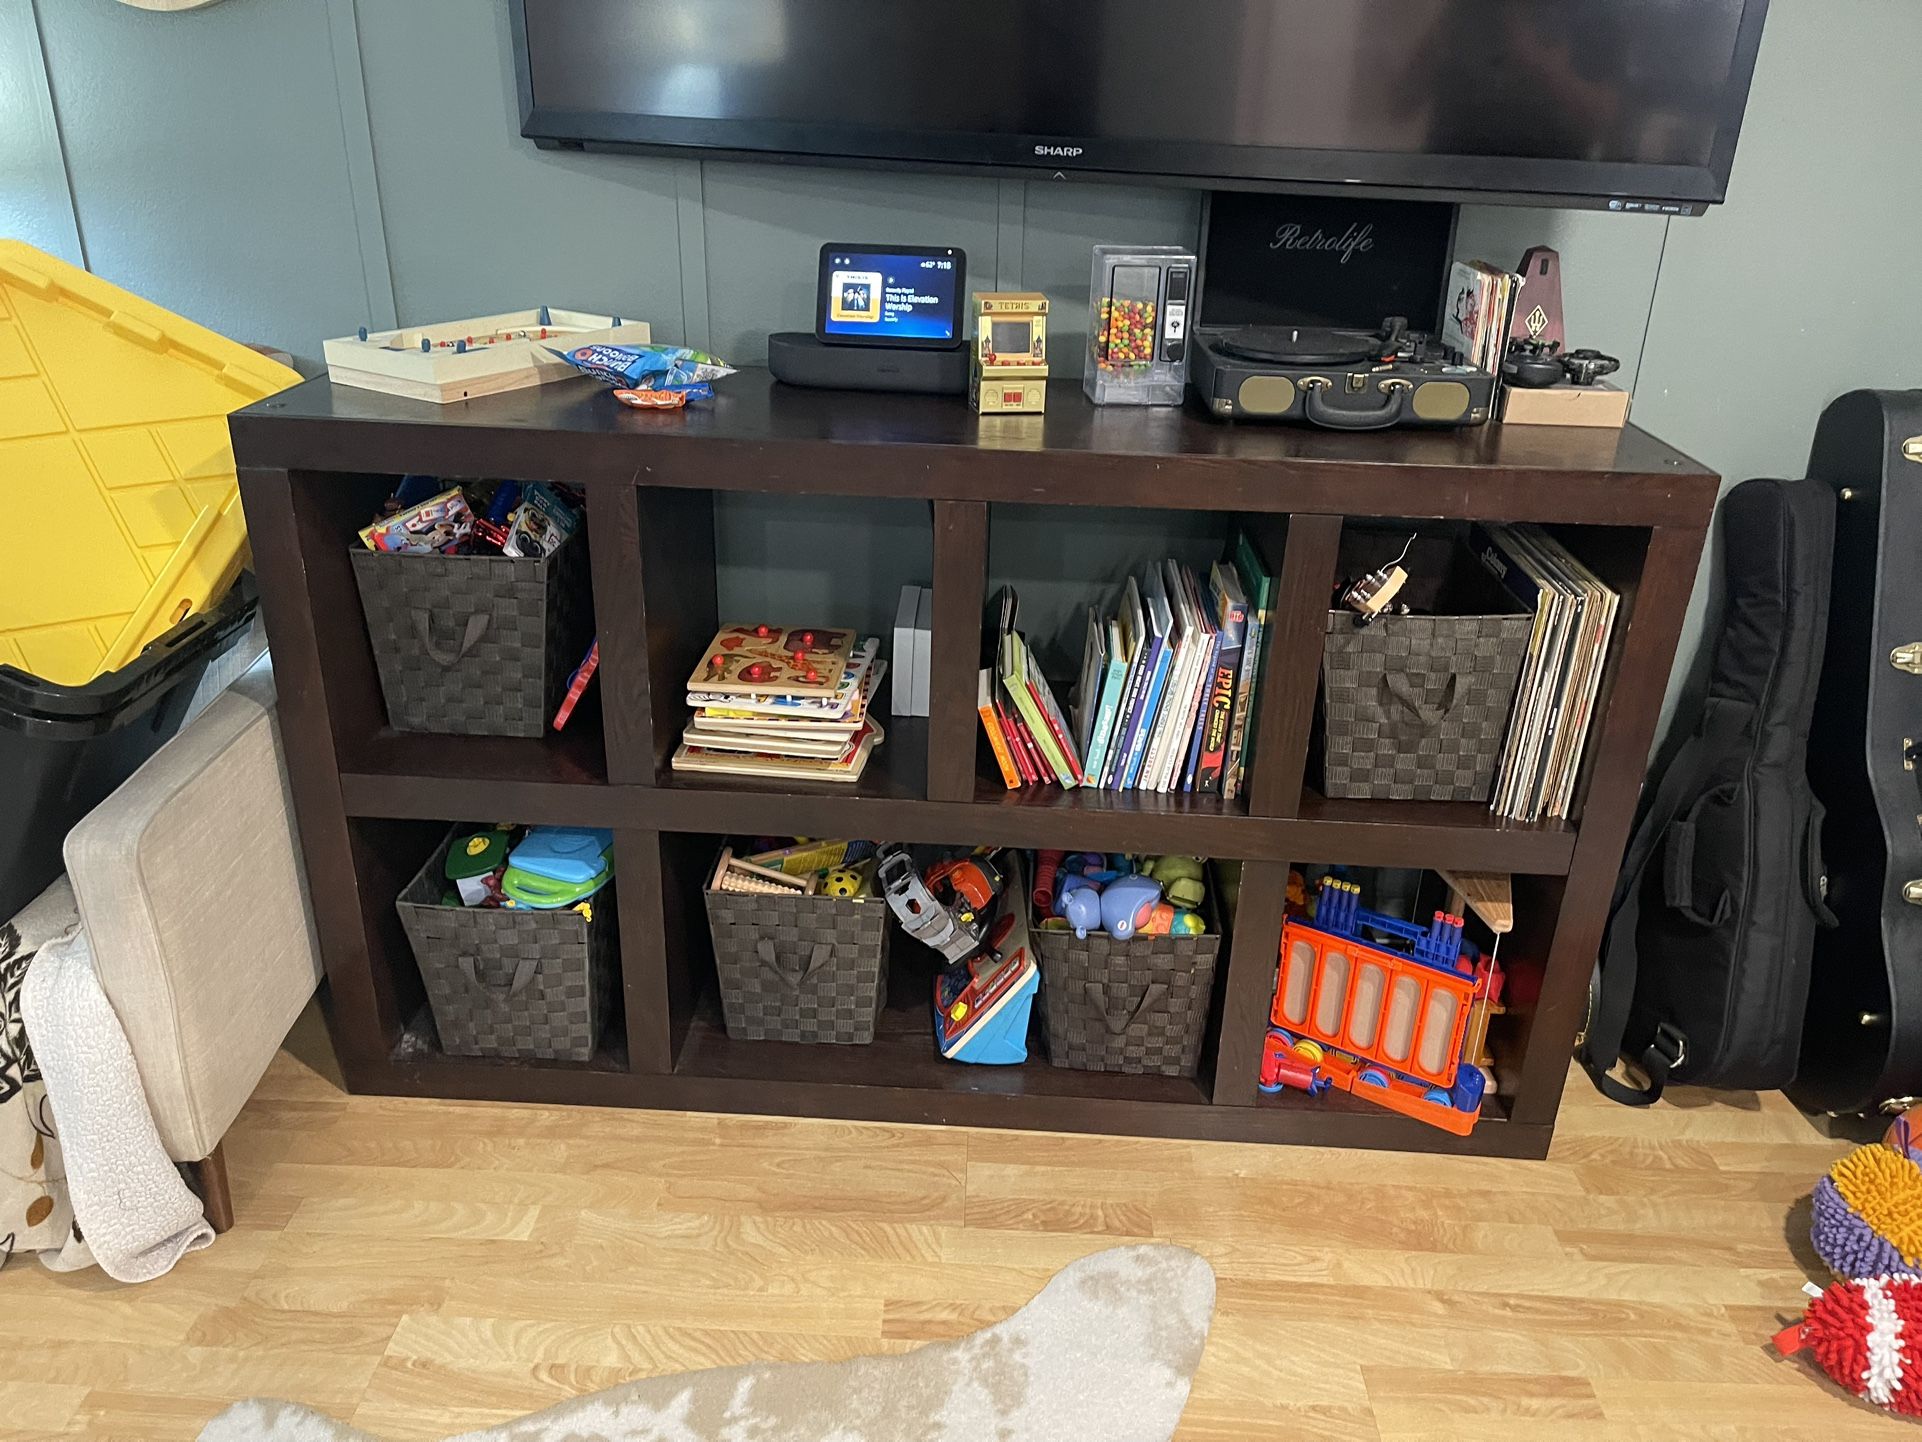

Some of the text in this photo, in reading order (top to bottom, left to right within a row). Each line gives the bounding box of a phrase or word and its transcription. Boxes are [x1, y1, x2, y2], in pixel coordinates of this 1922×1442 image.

[1034, 145, 1083, 157] SHARP
[1269, 222, 1373, 264] Retrolife
[885, 294, 900, 302] This
[907, 294, 939, 304] Elevation
[884, 302, 914, 313] Worship
[1212, 666, 1234, 710] EPIC
